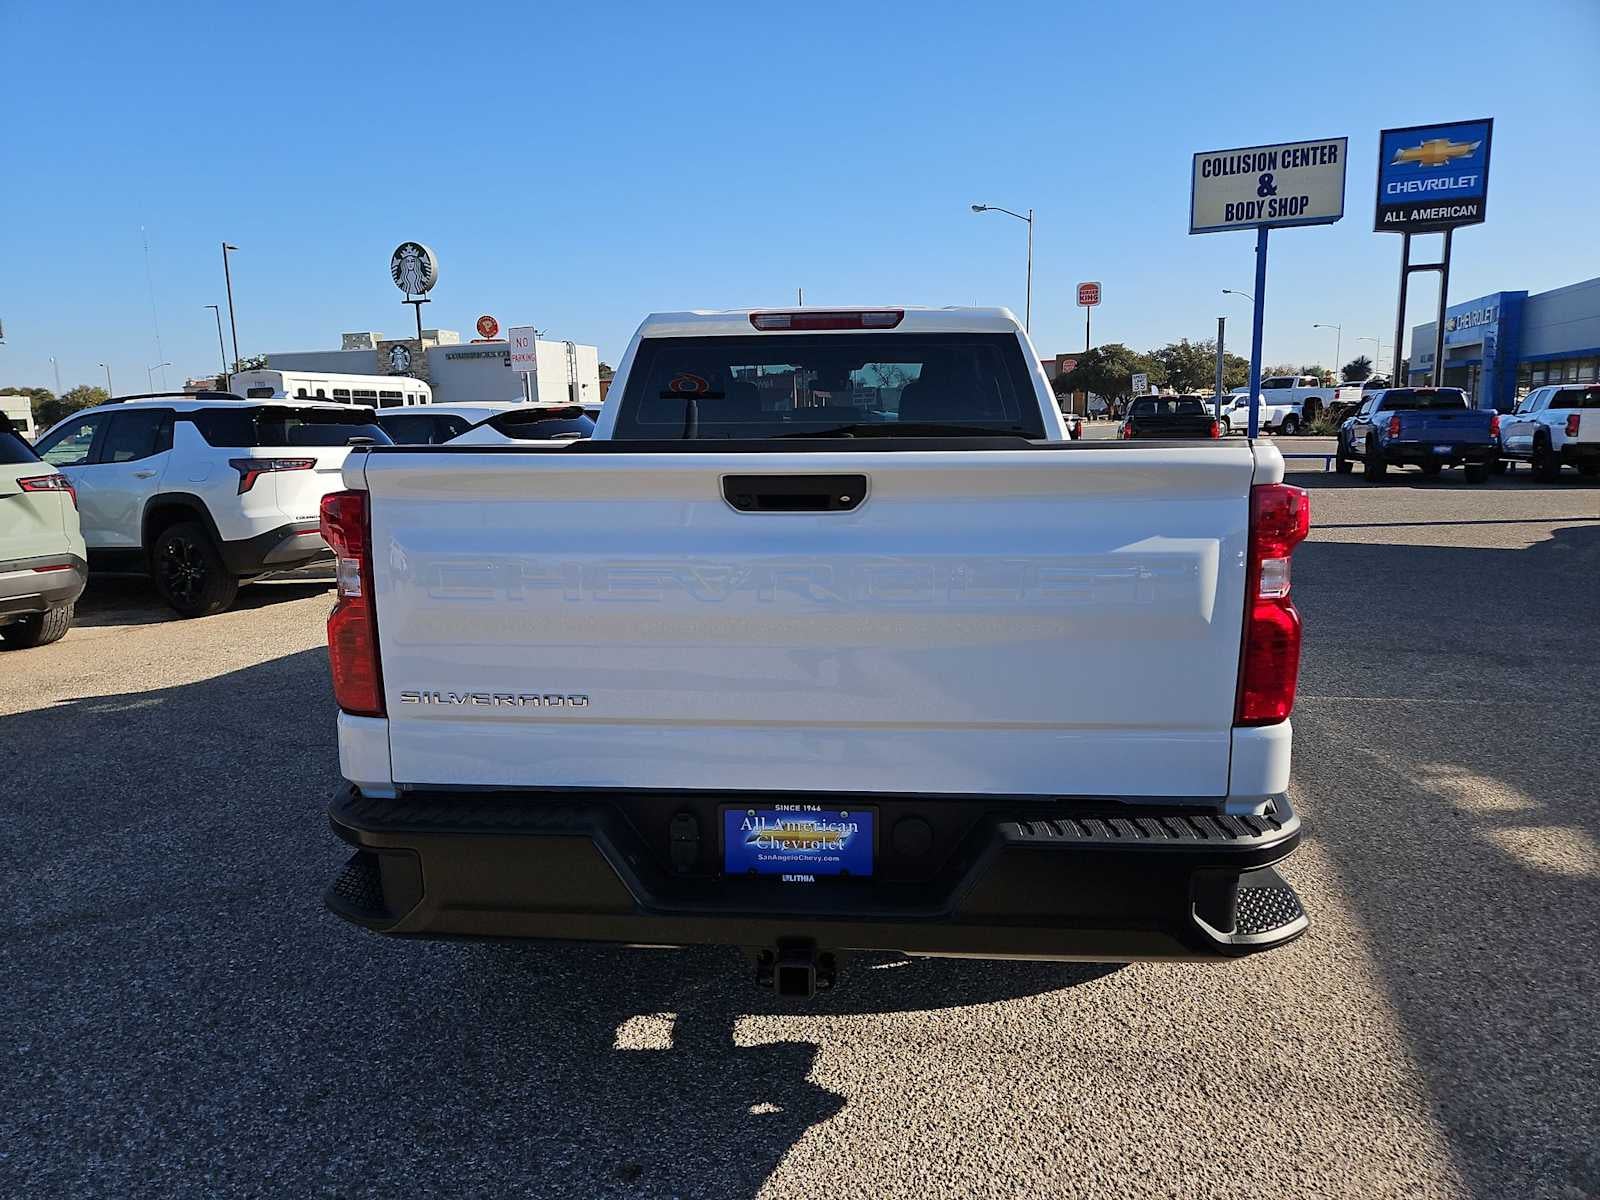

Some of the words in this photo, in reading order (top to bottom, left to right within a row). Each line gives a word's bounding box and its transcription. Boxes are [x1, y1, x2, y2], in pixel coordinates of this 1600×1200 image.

[1202, 151, 1277, 178] COLLISION
[1281, 144, 1338, 169] CENTER
[1257, 173, 1277, 197] &
[1387, 175, 1478, 194] CHEVROLET
[1225, 200, 1265, 222] BODY
[1268, 195, 1309, 218] SHOP
[1384, 211, 1407, 222] ALL
[1410, 205, 1477, 220] AMERICAN
[516, 337, 528, 348] NO
[512, 353, 536, 362] PARKING
[427, 557, 1193, 603] CHEVROLET
[400, 691, 589, 707] SILVERADO
[775, 804, 800, 812] SINCE
[740, 817, 766, 831] All
[774, 818, 859, 833] American
[756, 835, 845, 850] Chevrolet
[758, 854, 840, 863] SanAngeloChevy.com
